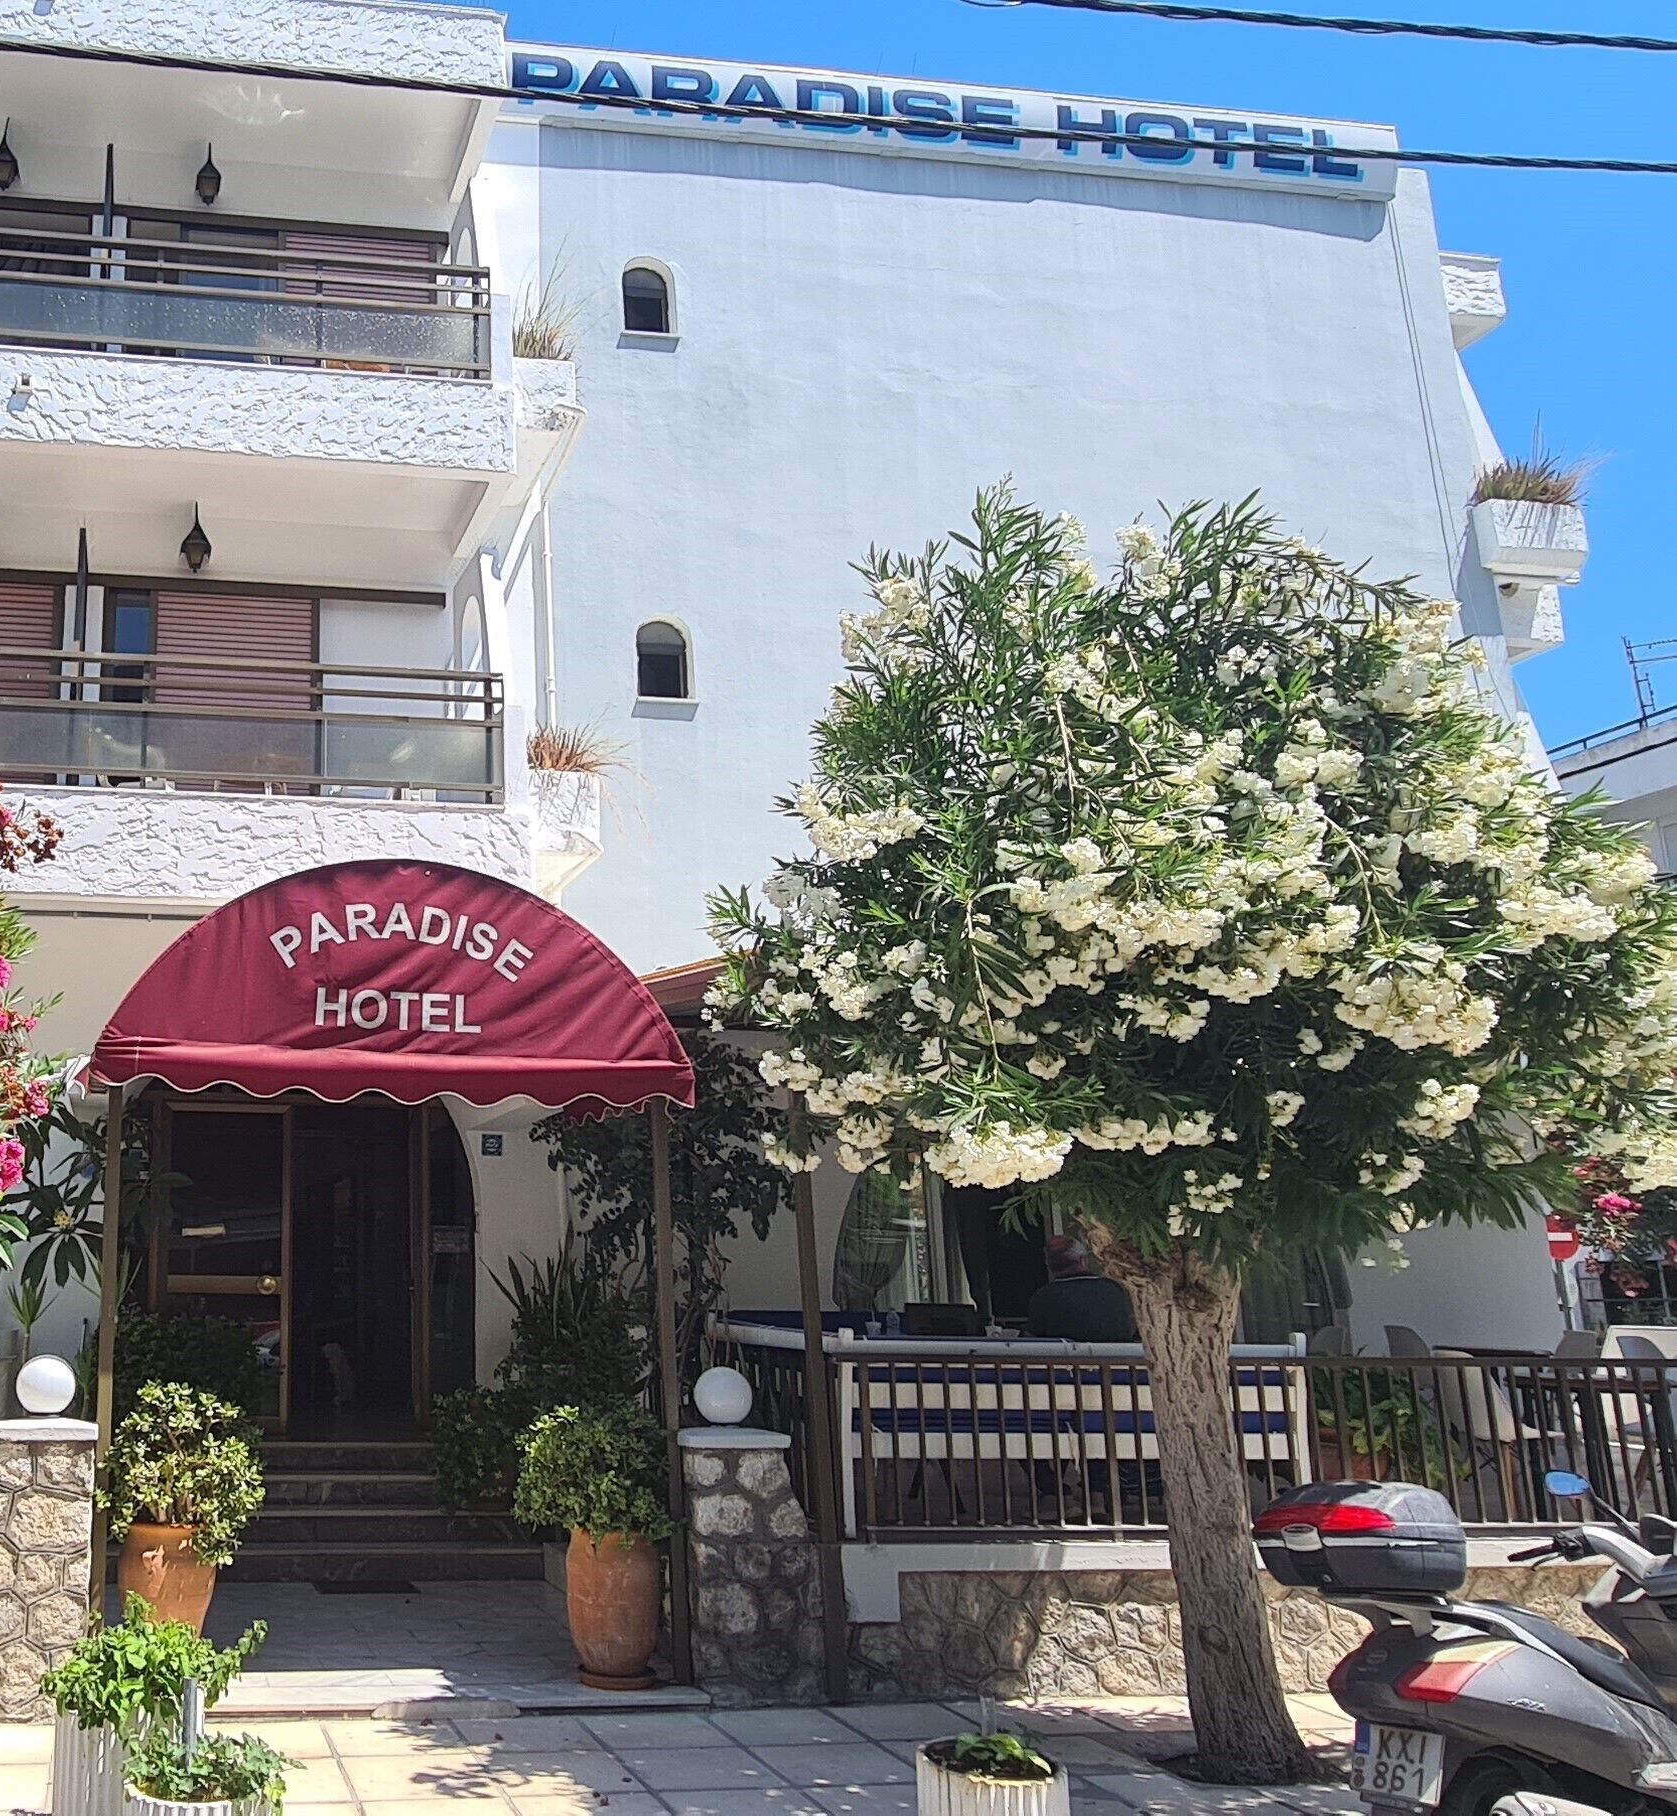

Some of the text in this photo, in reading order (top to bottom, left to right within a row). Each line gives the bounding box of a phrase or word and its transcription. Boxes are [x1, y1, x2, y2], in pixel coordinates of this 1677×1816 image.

[512, 54, 1364, 182] PARADISE HOTEL
[270, 903, 534, 982] PARADISE
[315, 988, 481, 1033] HOTEL
[1372, 1761, 1424, 1796] 861
